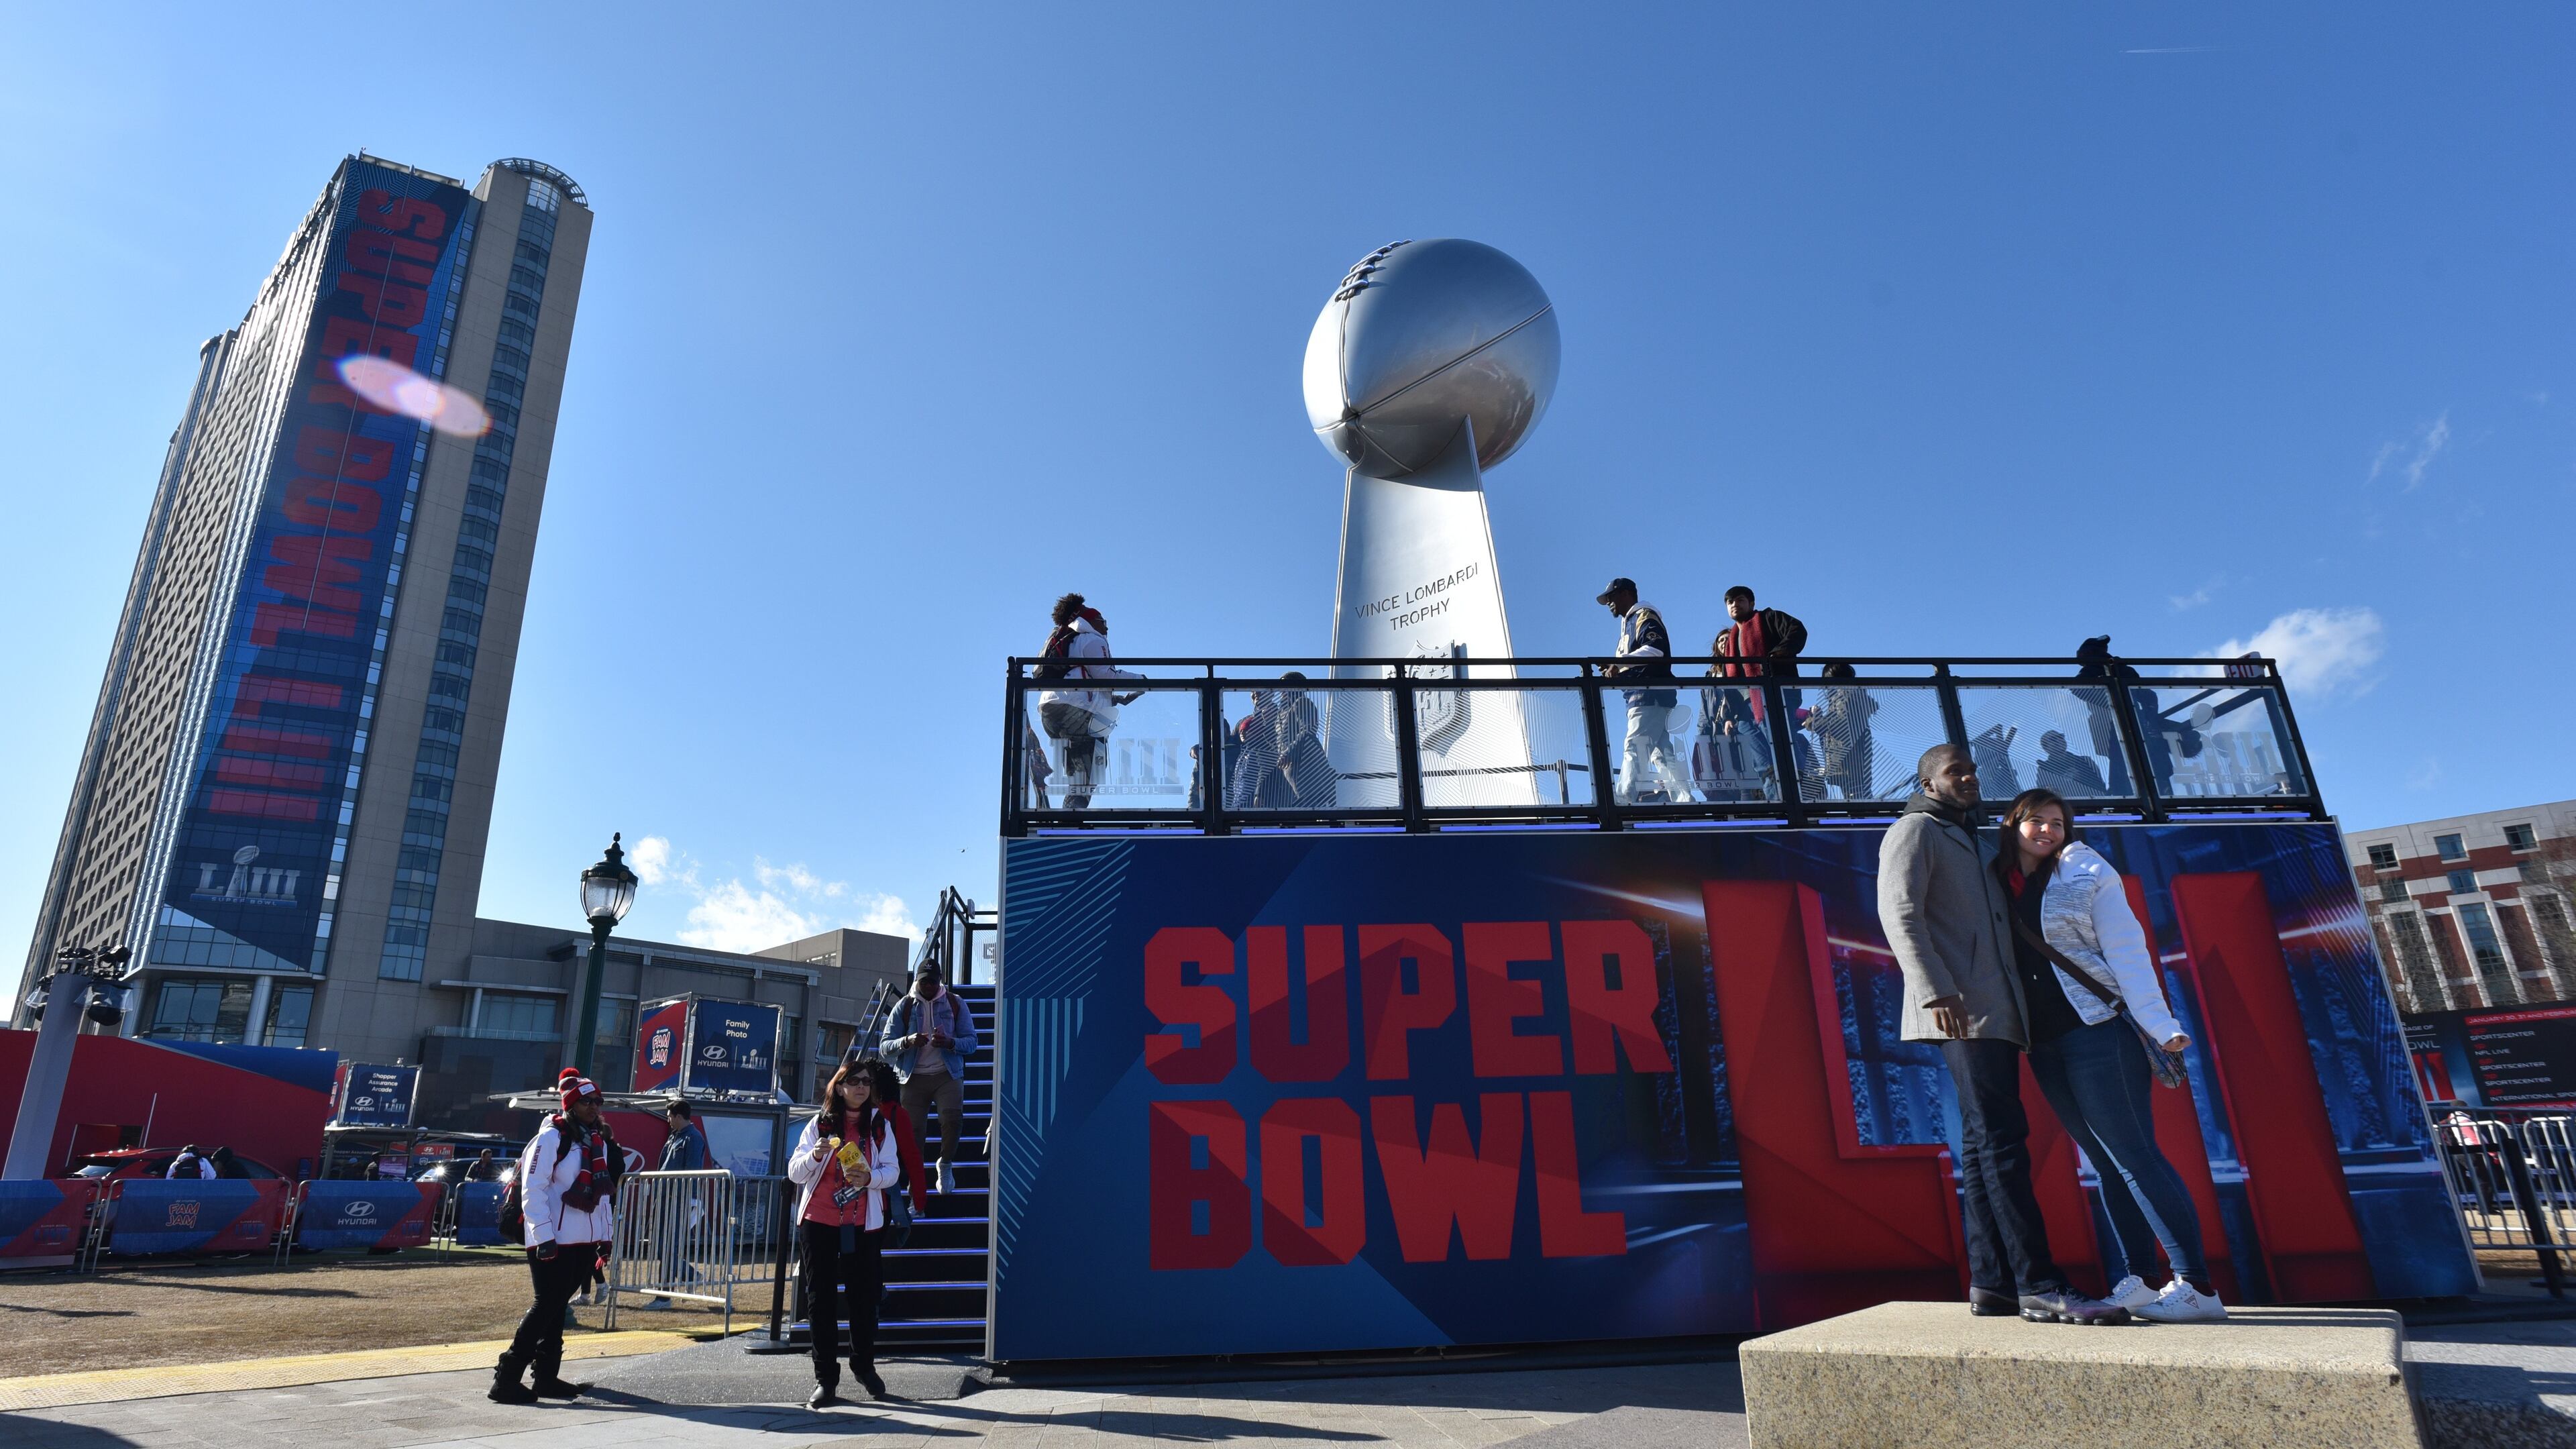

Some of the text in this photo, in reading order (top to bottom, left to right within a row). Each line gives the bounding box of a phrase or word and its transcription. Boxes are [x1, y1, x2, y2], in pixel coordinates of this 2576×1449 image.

[209, 189, 446, 822] SUPER BOWL LIII
[1355, 562, 1478, 619] VINCE LOMBARDI
[1390, 598, 1450, 631] TROPHY
[1144, 920, 1674, 1085] SUPER
[726, 1019, 750, 1029] Family
[652, 1031, 670, 1050] FAM
[726, 1030, 747, 1038] Photo
[2469, 1031, 2535, 1040] SPORTSCENTER
[650, 1049, 668, 1067] JAM
[697, 1059, 729, 1068] HYUNDAI
[2479, 1061, 2546, 1071] SPORTSCENTER
[2485, 1077, 2552, 1086] SPORTSCENTER
[529, 1144, 542, 1174] VOLUNTEER
[1149, 1091, 1627, 1271] BOWL
[168, 1201, 201, 1216] FAM
[166, 1214, 197, 1229] JAM
